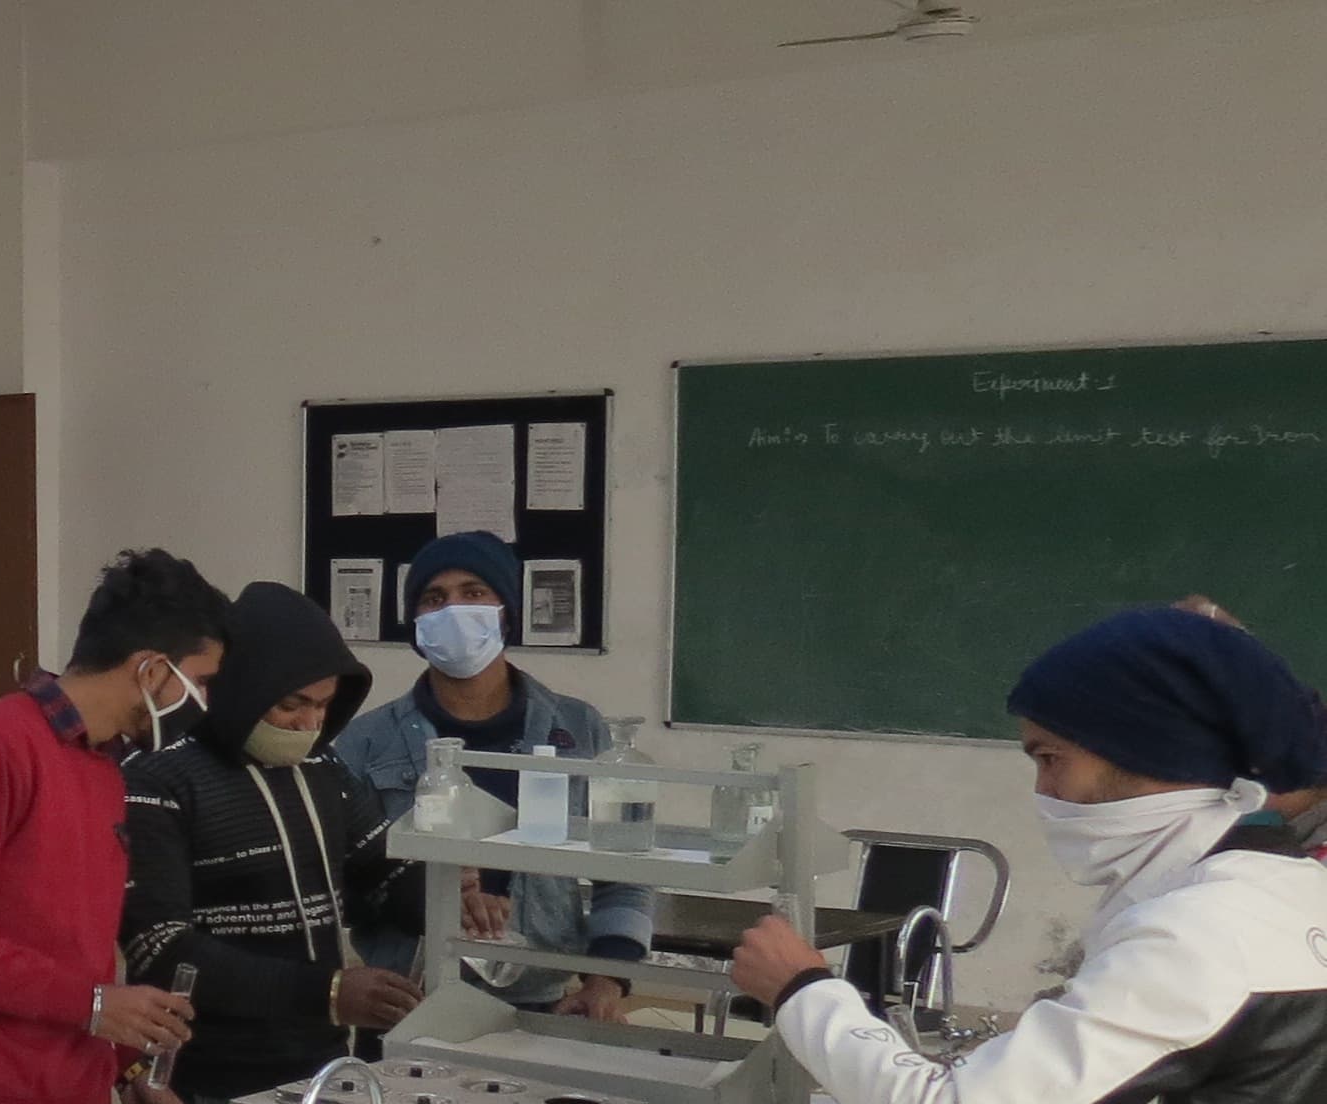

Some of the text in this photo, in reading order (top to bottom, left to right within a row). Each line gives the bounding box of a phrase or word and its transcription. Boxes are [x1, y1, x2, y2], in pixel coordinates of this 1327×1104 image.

[993, 426, 1034, 447] the
[1131, 426, 1193, 447] test
[205, 912, 274, 924] adventure
[250, 921, 295, 935] escape
